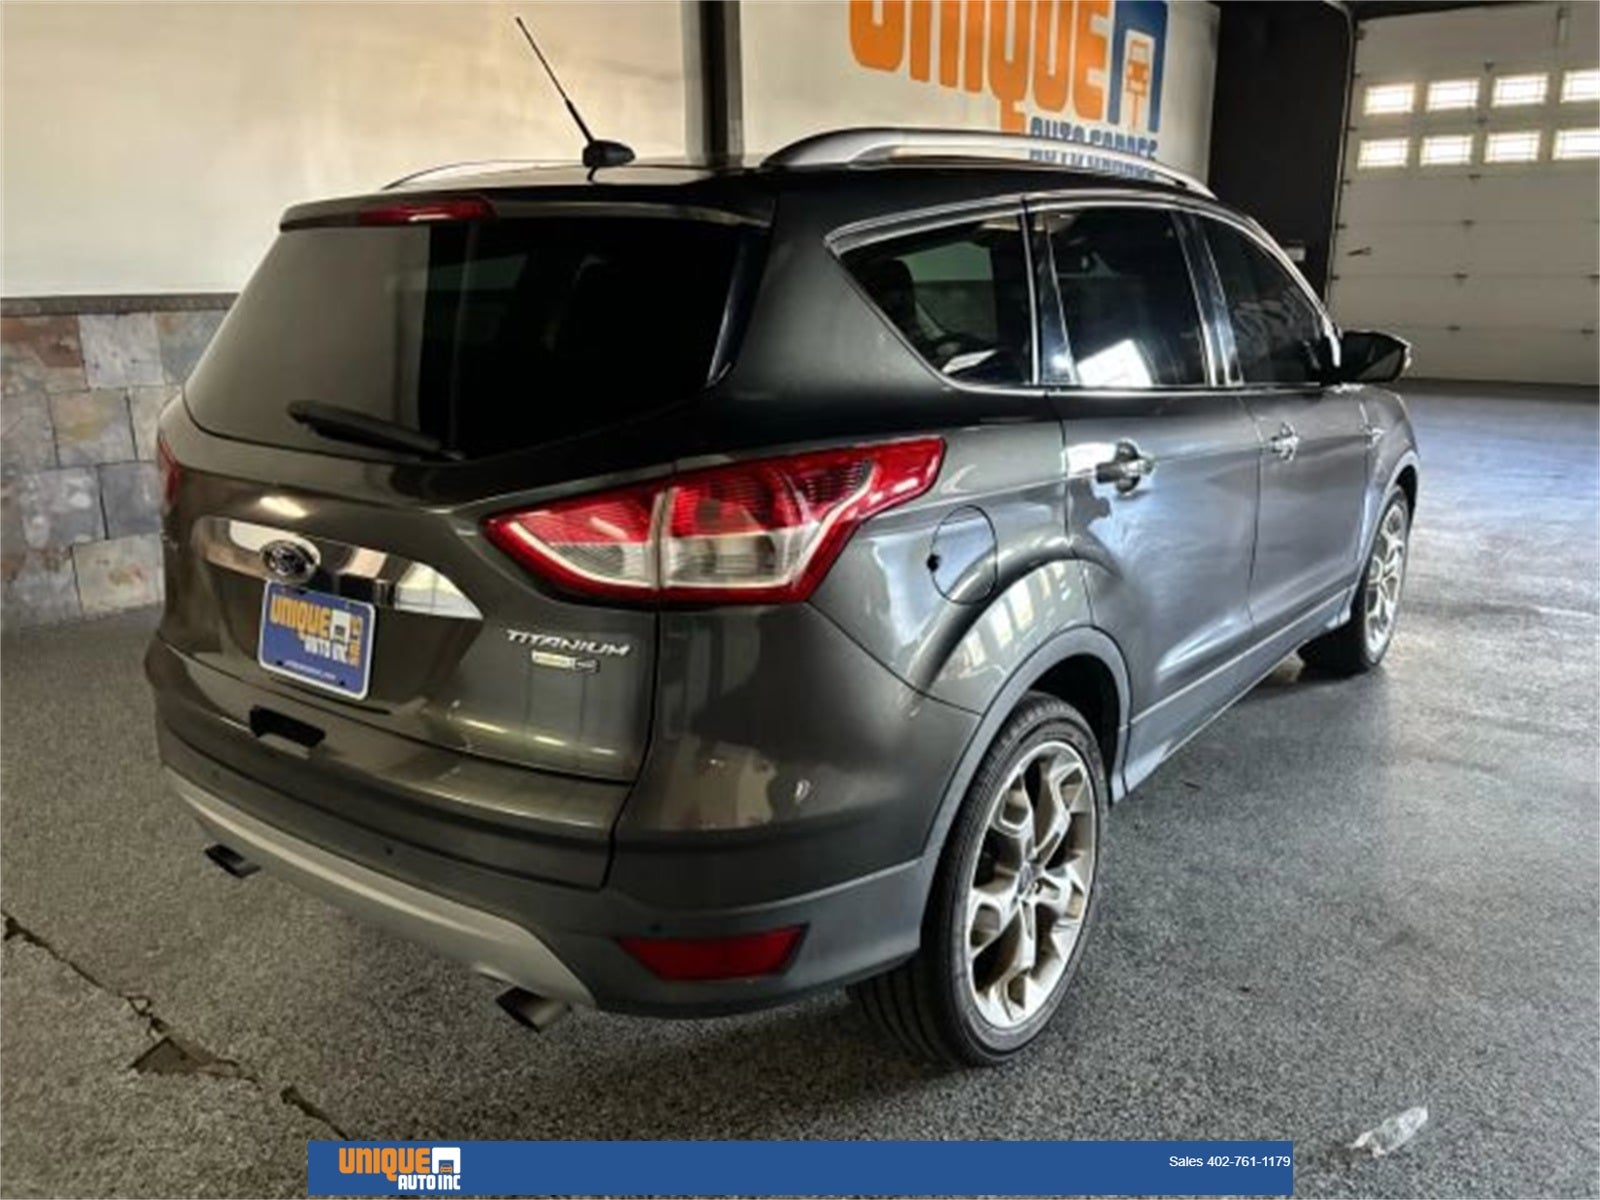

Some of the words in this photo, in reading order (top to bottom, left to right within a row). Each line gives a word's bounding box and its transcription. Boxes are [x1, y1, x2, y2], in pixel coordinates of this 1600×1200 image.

[270, 595, 332, 640] UNIQUE
[303, 635, 331, 658] AUTO
[331, 642, 350, 663] INC
[506, 628, 630, 655] TITANIUM
